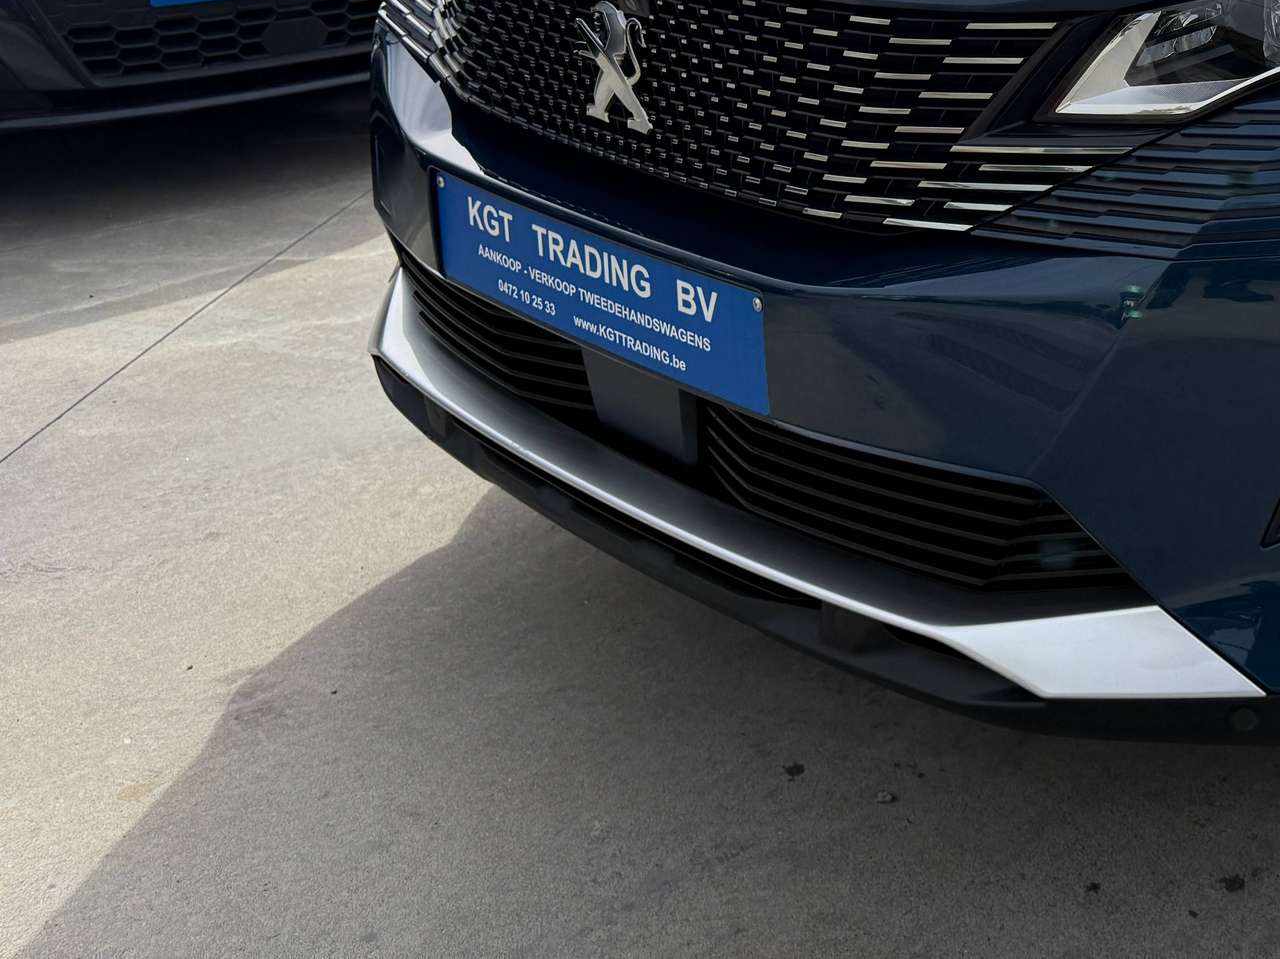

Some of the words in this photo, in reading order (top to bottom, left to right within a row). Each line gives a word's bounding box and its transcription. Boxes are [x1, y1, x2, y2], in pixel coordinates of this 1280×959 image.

[467, 196, 513, 242] KGT
[531, 223, 652, 299] TRADING
[676, 279, 718, 323] BV
[478, 244, 522, 273] AANKOOP
[528, 266, 577, 297] VERKOOP
[577, 287, 712, 352] TWEEDEHANDSWAGENS
[498, 279, 519, 299] 0472
[519, 289, 531, 304] 10
[531, 295, 544, 310] 25
[544, 300, 556, 316] 33
[573, 315, 687, 372] www.KGTTRADING.be
